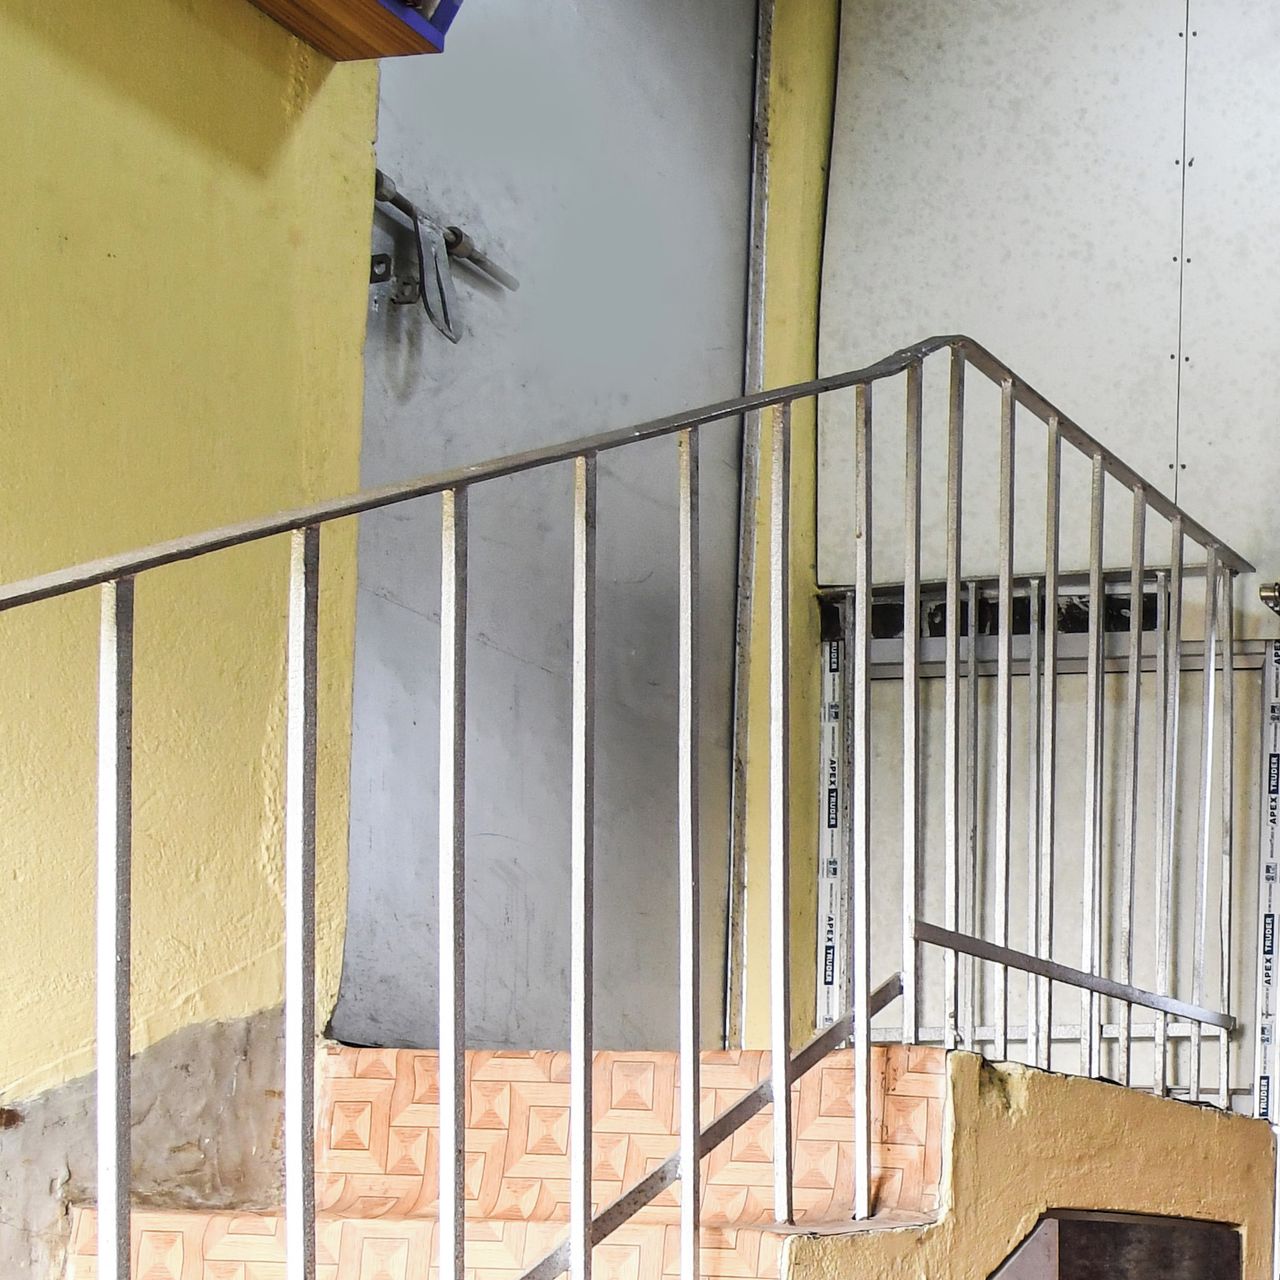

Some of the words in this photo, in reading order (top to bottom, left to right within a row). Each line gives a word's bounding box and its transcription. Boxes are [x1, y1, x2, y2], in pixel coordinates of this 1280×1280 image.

[830, 642, 838, 669] RUDER
[829, 759, 837, 786] APEX
[1270, 756, 1279, 793] TRUDER
[829, 790, 837, 826] TRUDER
[1269, 796, 1278, 825] APEX
[826, 916, 834, 943] APEX
[1265, 916, 1274, 954] TRUDER
[825, 947, 834, 983] TRUDER
[1264, 957, 1272, 986] APEX
[1259, 1078, 1269, 1116] TRUDER
